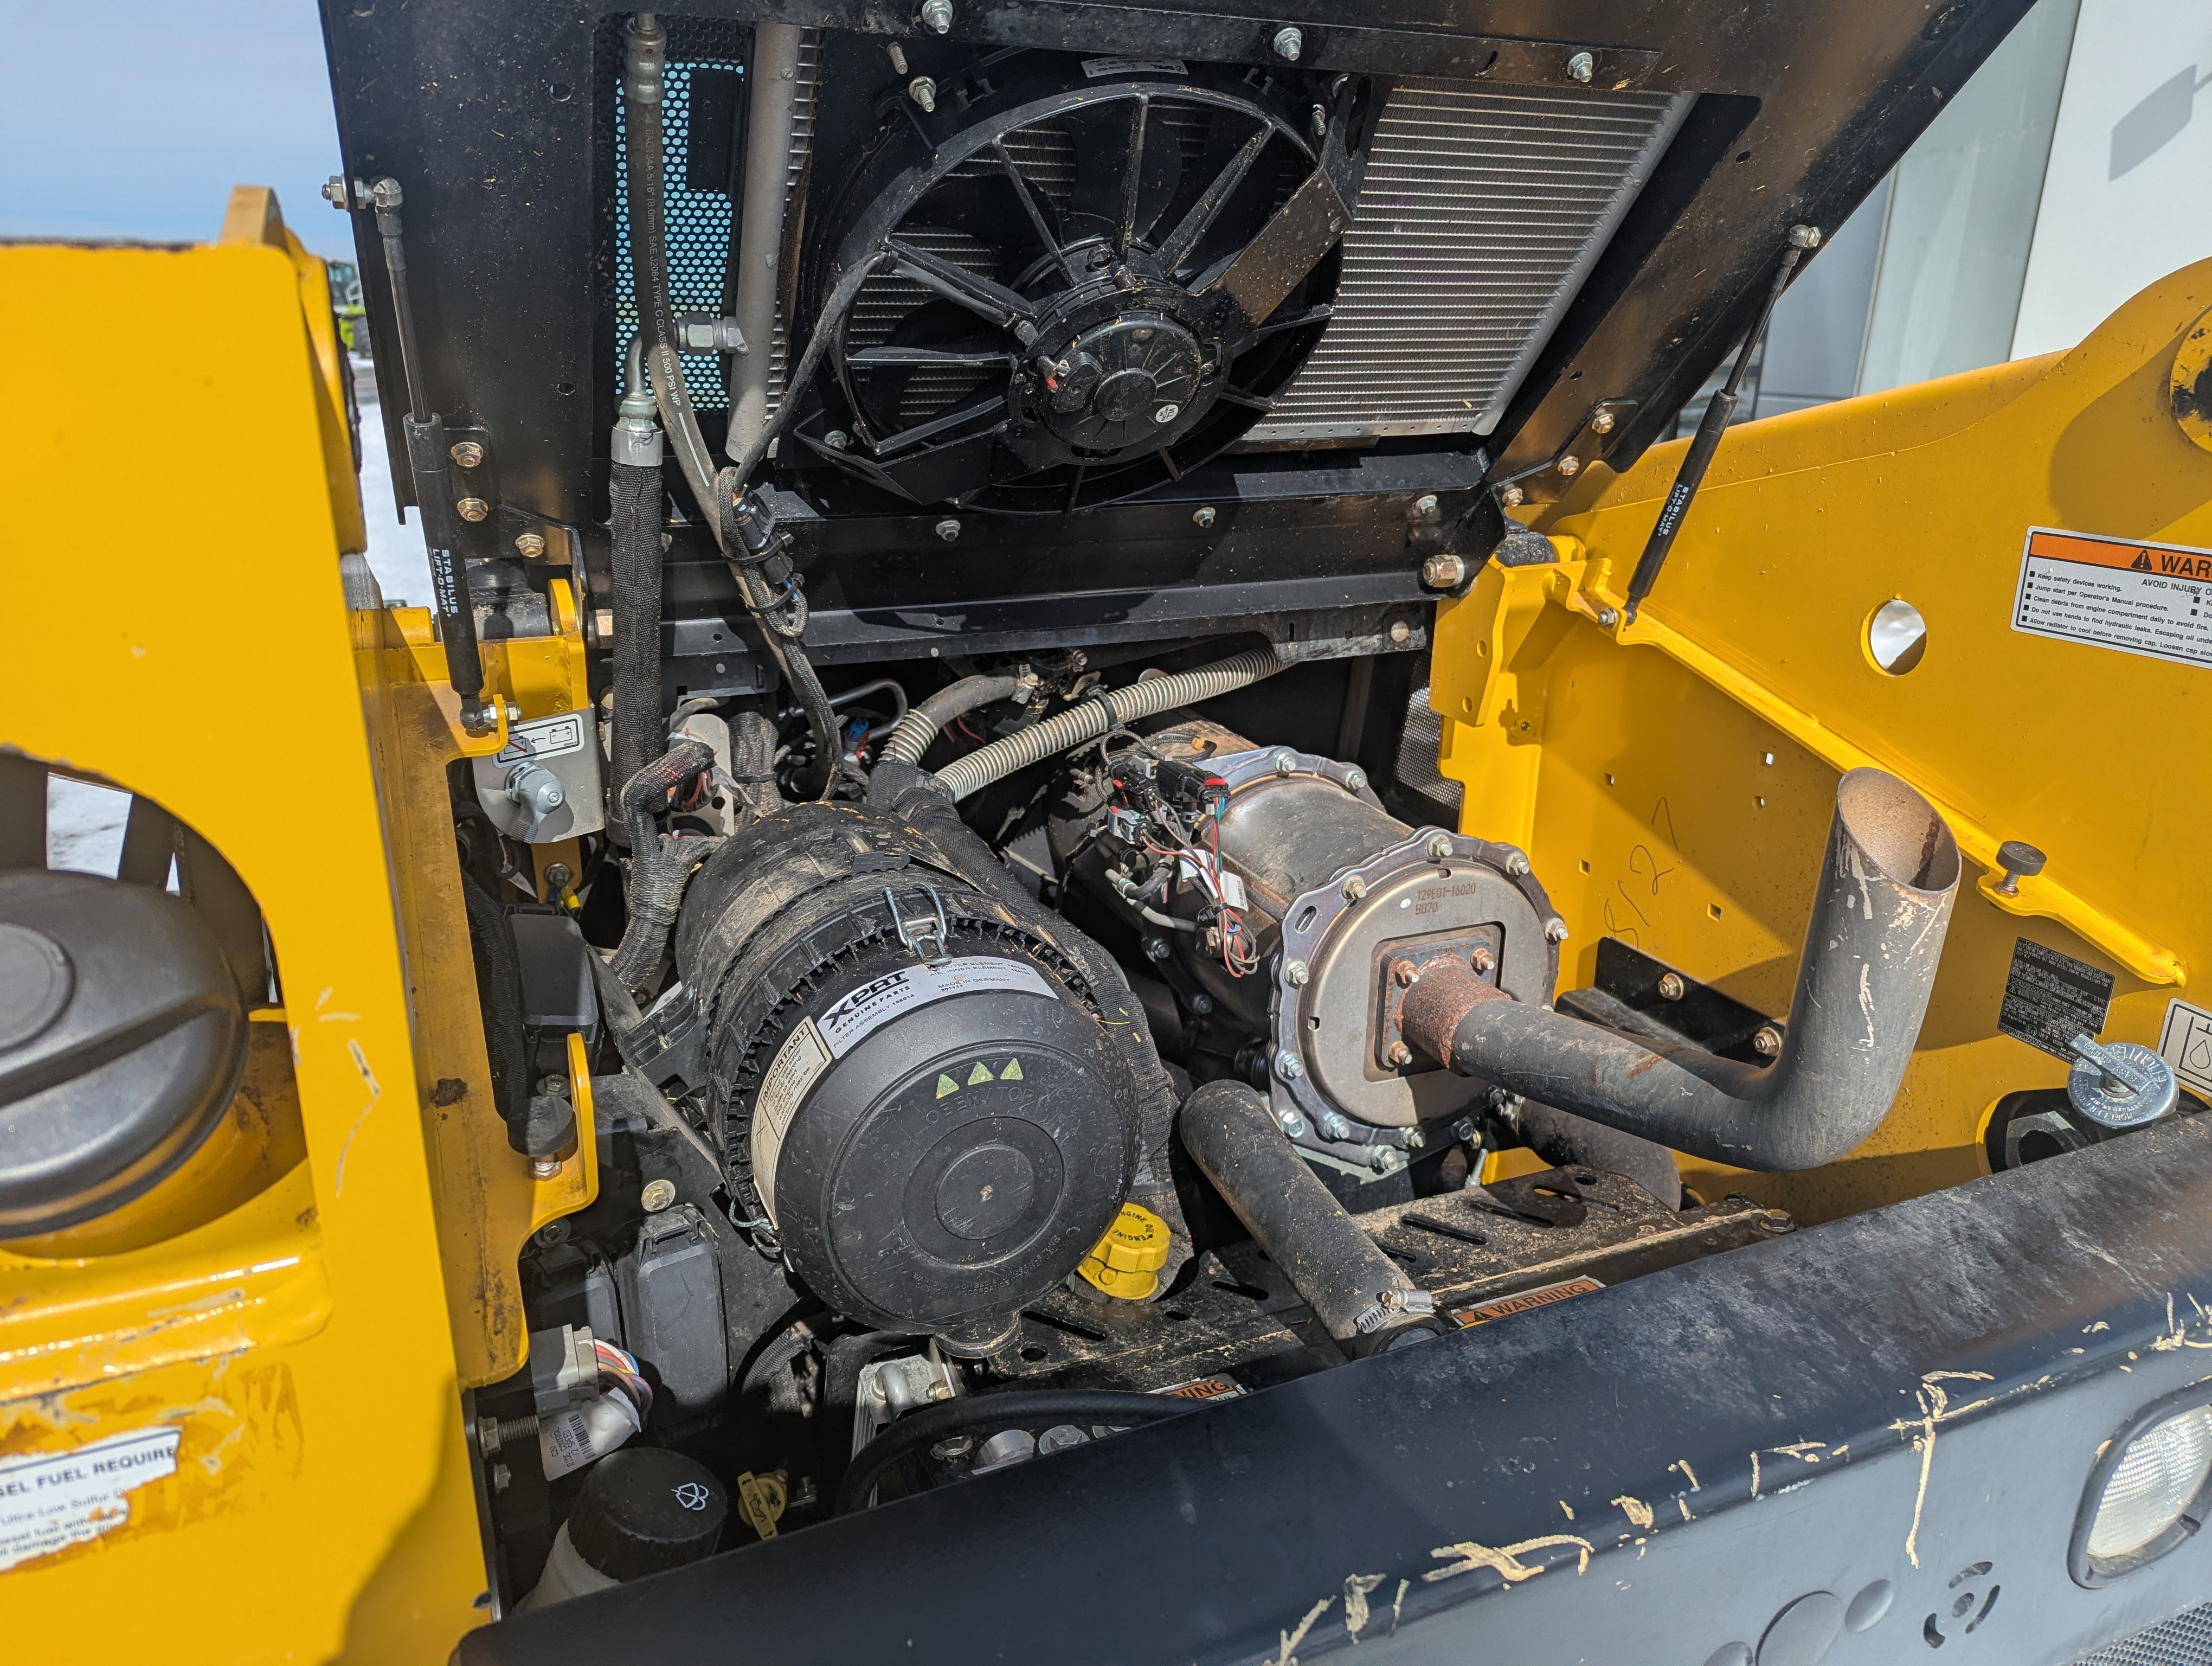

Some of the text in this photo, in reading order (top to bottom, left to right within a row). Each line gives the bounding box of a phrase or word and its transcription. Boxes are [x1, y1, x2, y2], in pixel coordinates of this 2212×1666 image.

[647, 199, 656, 233] (8.0mm)
[649, 236, 657, 254] SAE
[650, 256, 659, 281] J2064
[653, 283, 663, 308] TYPE
[656, 319, 667, 349] CLASS
[663, 358, 672, 374] 500
[666, 375, 676, 390] PSI
[671, 392, 681, 406] WP
[1166, 408, 1175, 419] VLL
[1662, 486, 1688, 535] STABILUS
[440, 549, 459, 613] STABILUS
[2037, 572, 2122, 592] Keep safety devices working.
[2141, 578, 2168, 589] AVOID
[2170, 583, 2202, 594] INJURY
[2035, 585, 2051, 593] Jump
[2079, 591, 2110, 603] Operator's
[2112, 597, 2134, 606] Manual
[2136, 601, 2169, 612] procedure.
[2033, 595, 2049, 604] Clean
[2050, 598, 2069, 607] debris
[2070, 601, 2084, 610] from
[2086, 604, 2106, 614] engine
[2107, 607, 2148, 621] compartment
[2150, 614, 2165, 625] daily
[2176, 619, 2195, 629] avoid
[2196, 623, 2209, 631] fire.
[2029, 617, 2045, 626] Allow
[2046, 620, 2068, 630] radiator
[2078, 626, 2091, 634] cool
[2092, 629, 2112, 638] before
[2113, 633, 2142, 645] removing
[2144, 638, 2157, 647] cap.
[2159, 641, 2184, 651] Loosen
[2185, 646, 2198, 656] cap
[2063, 612, 2081, 621] hands
[2091, 616, 2103, 625] find
[2105, 618, 2132, 631] hydraulic
[2134, 623, 2152, 633] leaks.
[2155, 628, 2184, 640] Escaping
[1417, 882, 1477, 903] 129E01-16020
[1415, 901, 1438, 916] BB70
[937, 981, 960, 989] MADE
[2008, 976, 2053, 999] YANMAR
[835, 985, 910, 1034] GENUINE PARTS
[833, 1028, 854, 1048] FILTER
[856, 1004, 890, 1030] ASSEMBLY
[1997, 1023, 2042, 1047] YANMAR
[762, 1027, 806, 1103] IMPORTANT
[769, 1091, 776, 1102] Do
[781, 1065, 789, 1078] use
[788, 1047, 801, 1065] ether
[785, 1054, 801, 1079] starting
[781, 1079, 796, 1103] engine
[782, 1084, 787, 1092] to
[787, 1067, 798, 1084] start
[779, 1066, 810, 1120] warranty may be
[781, 1100, 794, 1125] voided.
[926, 1091, 980, 1125] OBEN
[997, 1087, 1034, 1103] TOP
[1118, 1210, 1154, 1233] NGINE OIL
[1111, 1229, 1146, 1241] ENGINE
[1493, 1284, 1587, 1317] WARNING
[552, 1427, 574, 1467] RIDE CONTROL
[562, 1429, 575, 1447] SPEED
[36, 1469, 87, 1488] FUEL
